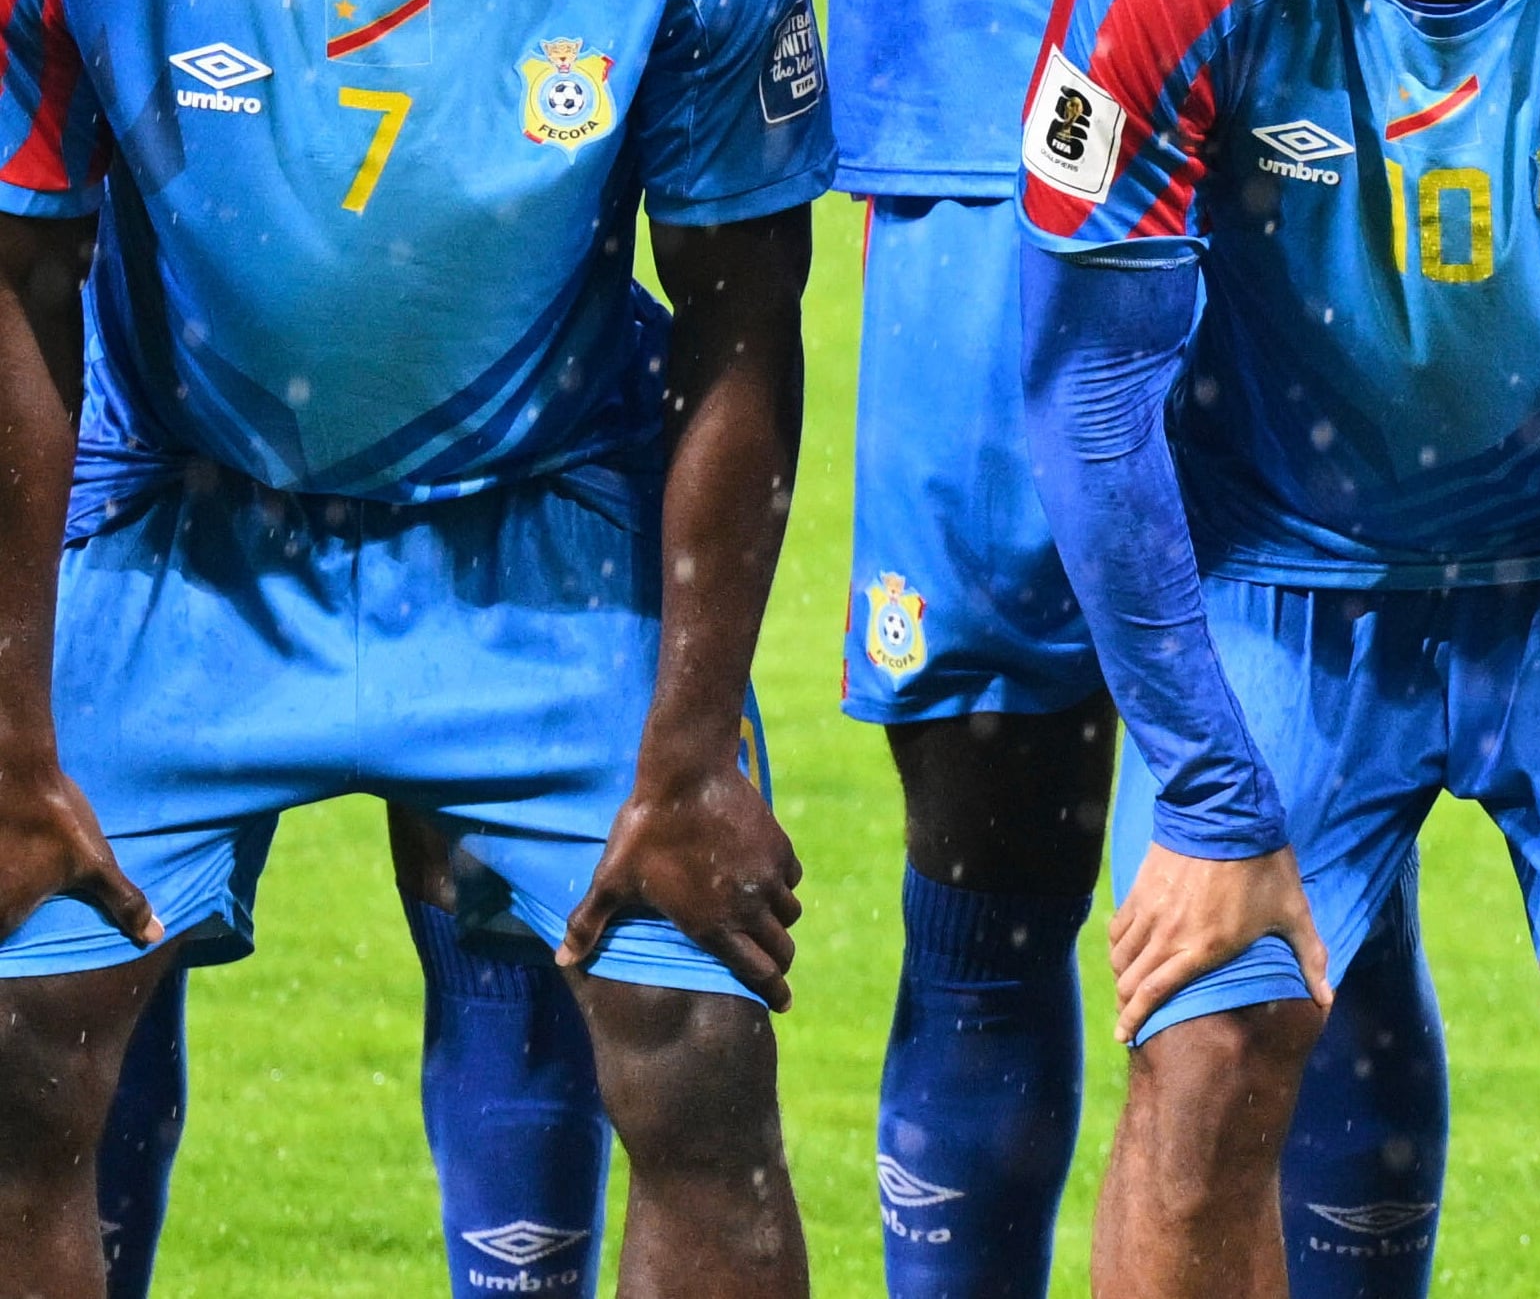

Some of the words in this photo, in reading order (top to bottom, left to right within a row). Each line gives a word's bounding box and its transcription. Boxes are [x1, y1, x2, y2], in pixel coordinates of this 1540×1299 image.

[770, 61, 795, 82] the
[796, 78, 814, 93] FIFA
[177, 89, 261, 114] umbro
[538, 120, 599, 140] FECOFA
[339, 86, 413, 214] 7
[1052, 139, 1072, 154] FIFA
[1259, 157, 1339, 185] umbro
[1385, 157, 1494, 283] 10
[880, 1204, 951, 1243] bro
[469, 1269, 577, 1292] umbro
